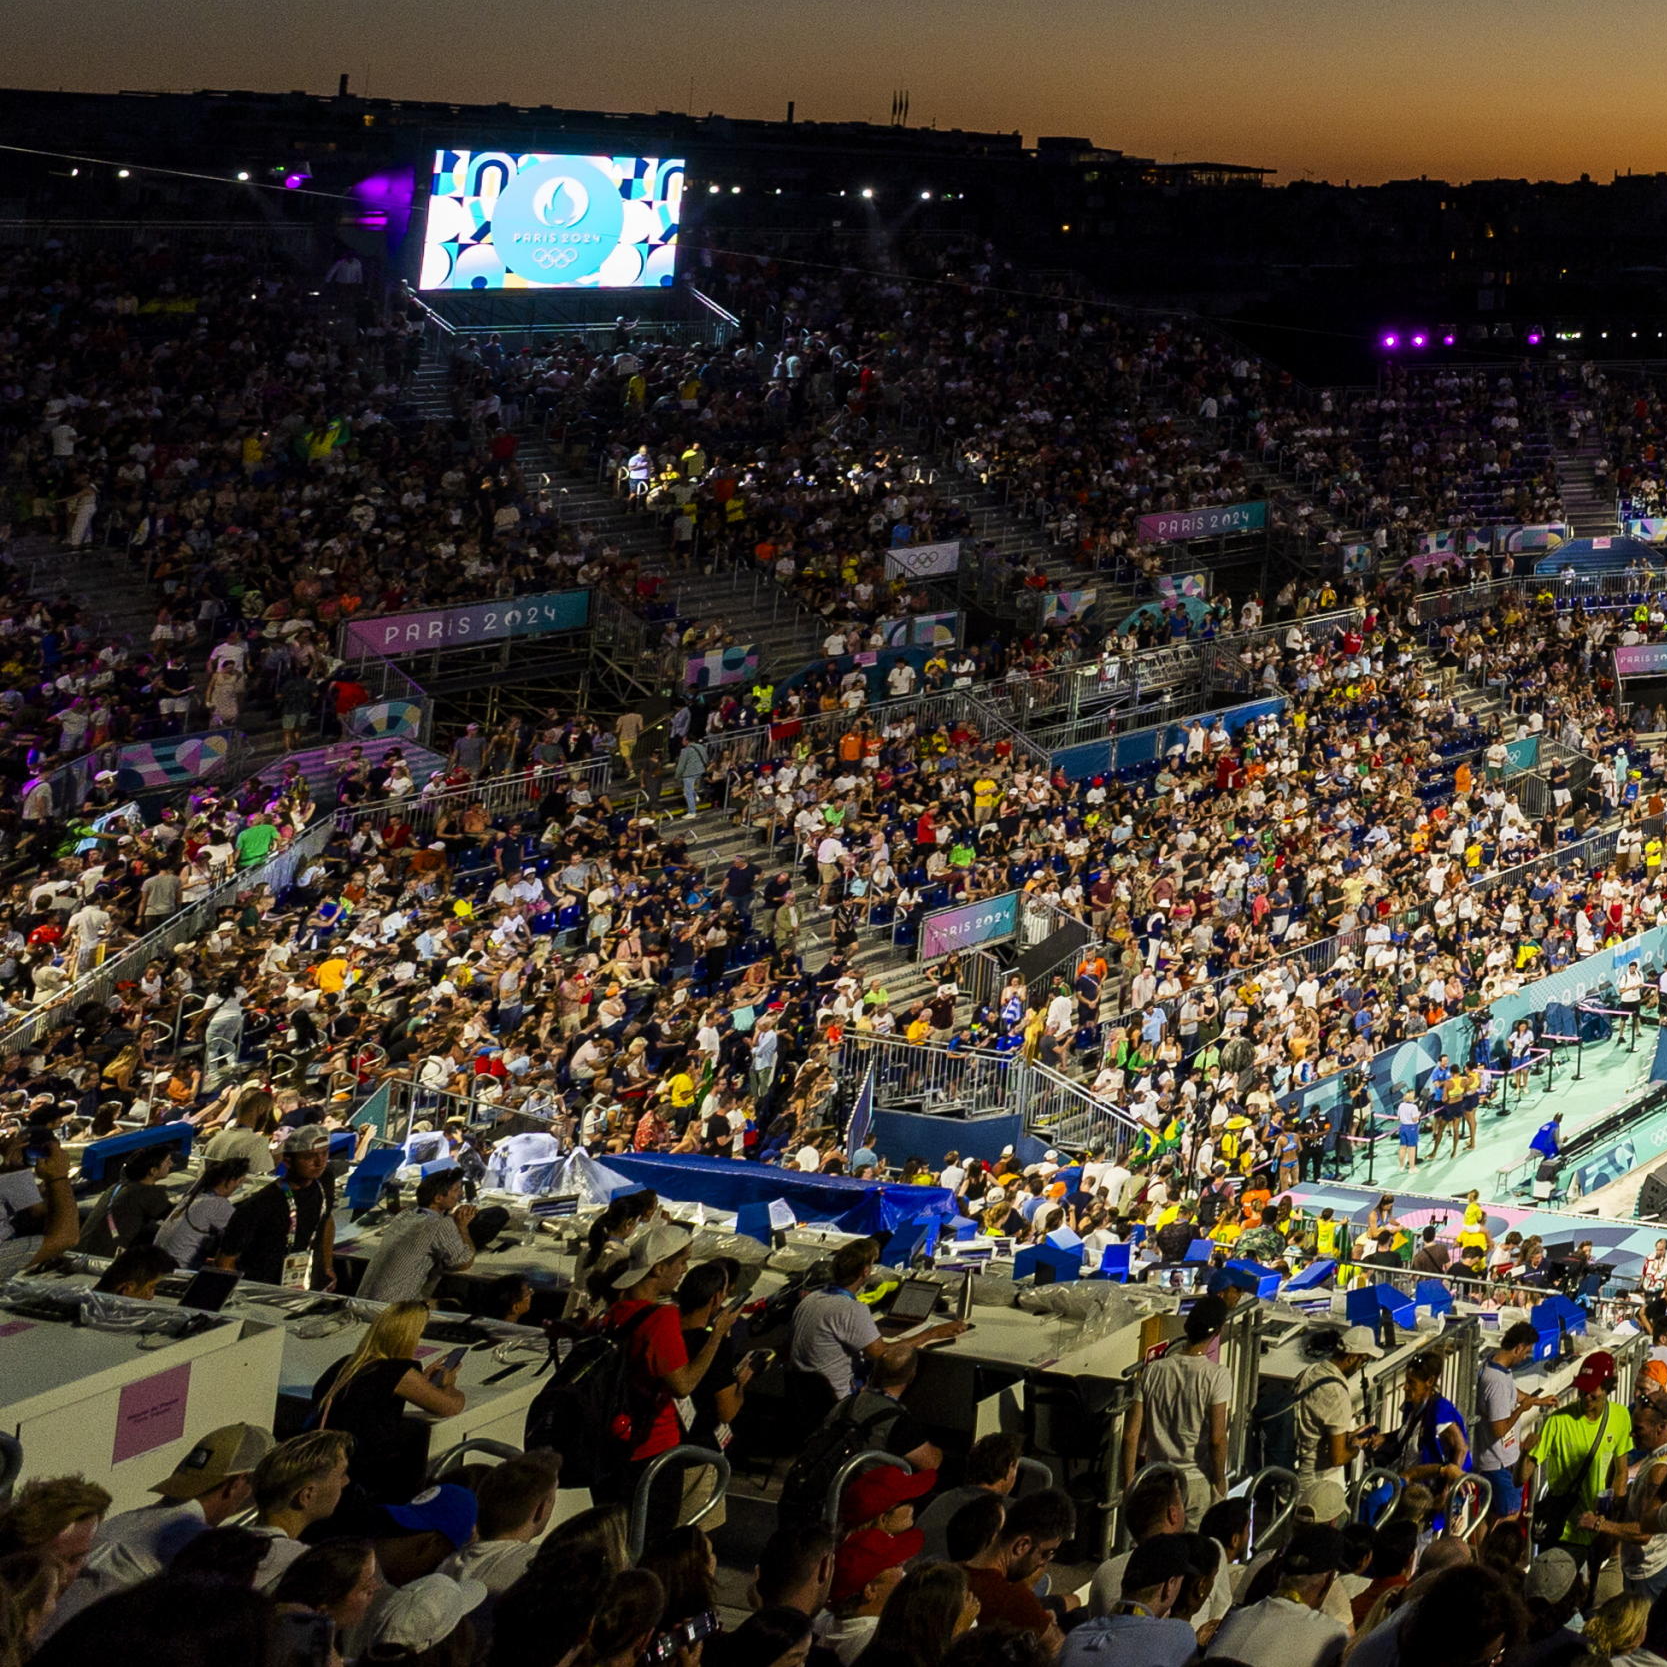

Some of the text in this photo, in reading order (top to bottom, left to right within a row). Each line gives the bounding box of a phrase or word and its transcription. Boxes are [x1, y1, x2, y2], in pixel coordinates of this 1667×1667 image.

[1159, 511, 1249, 534] PARIS 2024
[384, 605, 556, 645] PARIS 2024
[1620, 655, 1650, 664] PARIS
[975, 910, 1010, 929] 2024
